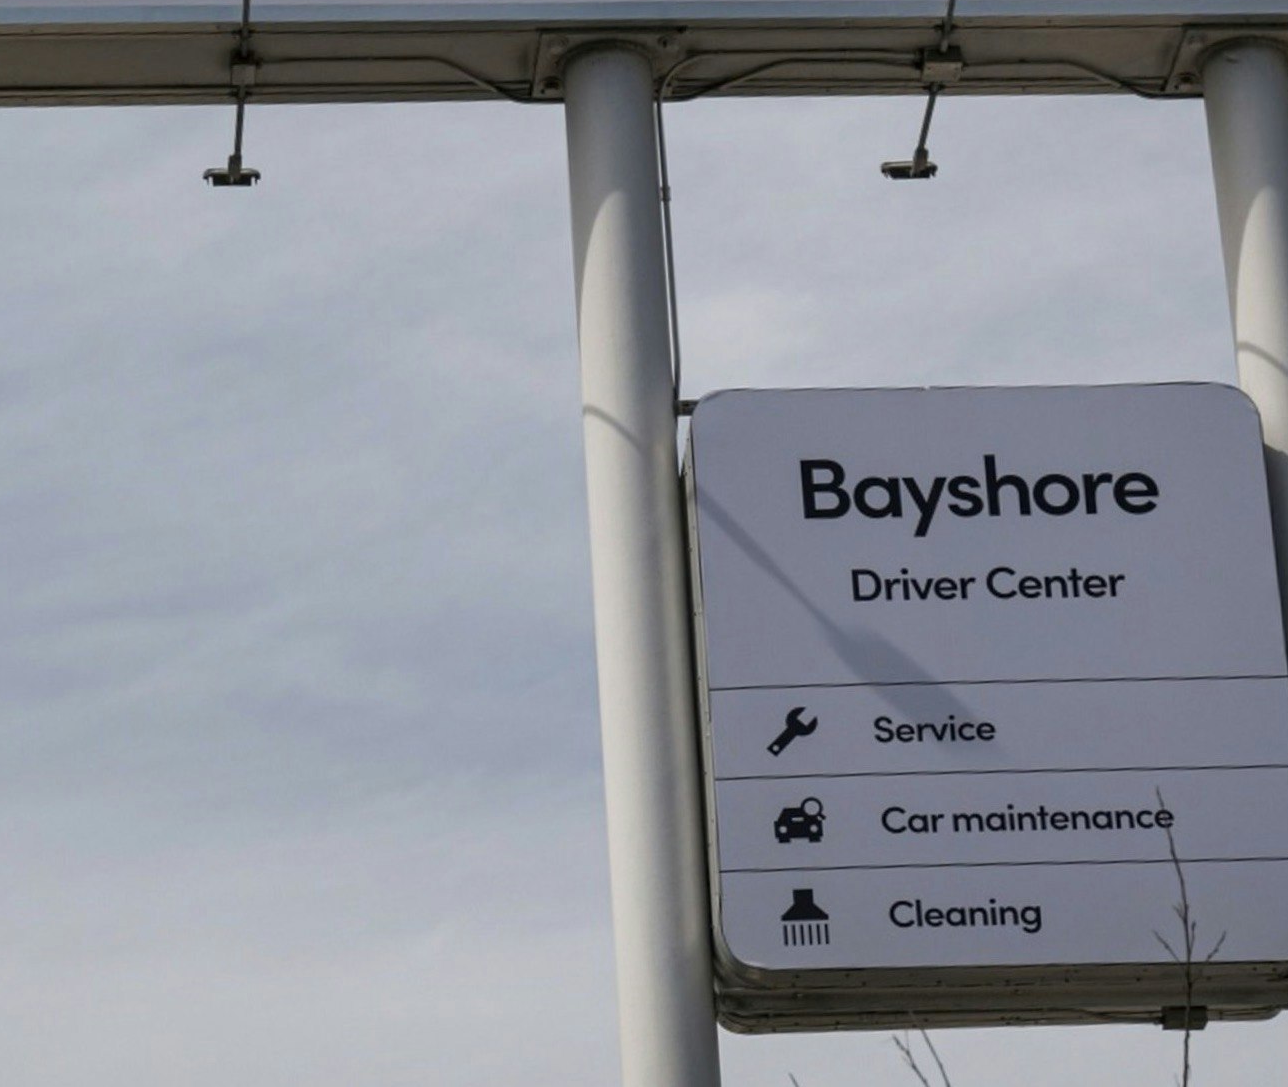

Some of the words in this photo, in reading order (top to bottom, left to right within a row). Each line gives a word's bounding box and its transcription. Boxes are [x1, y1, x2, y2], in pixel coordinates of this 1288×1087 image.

[799, 454, 1160, 537] Bayshore
[851, 568, 976, 602] Driver
[986, 567, 1126, 600] Center
[873, 715, 996, 743] Service
[881, 806, 945, 834] Car
[952, 804, 1175, 832] maintenance
[889, 899, 1042, 934] Cleaning
